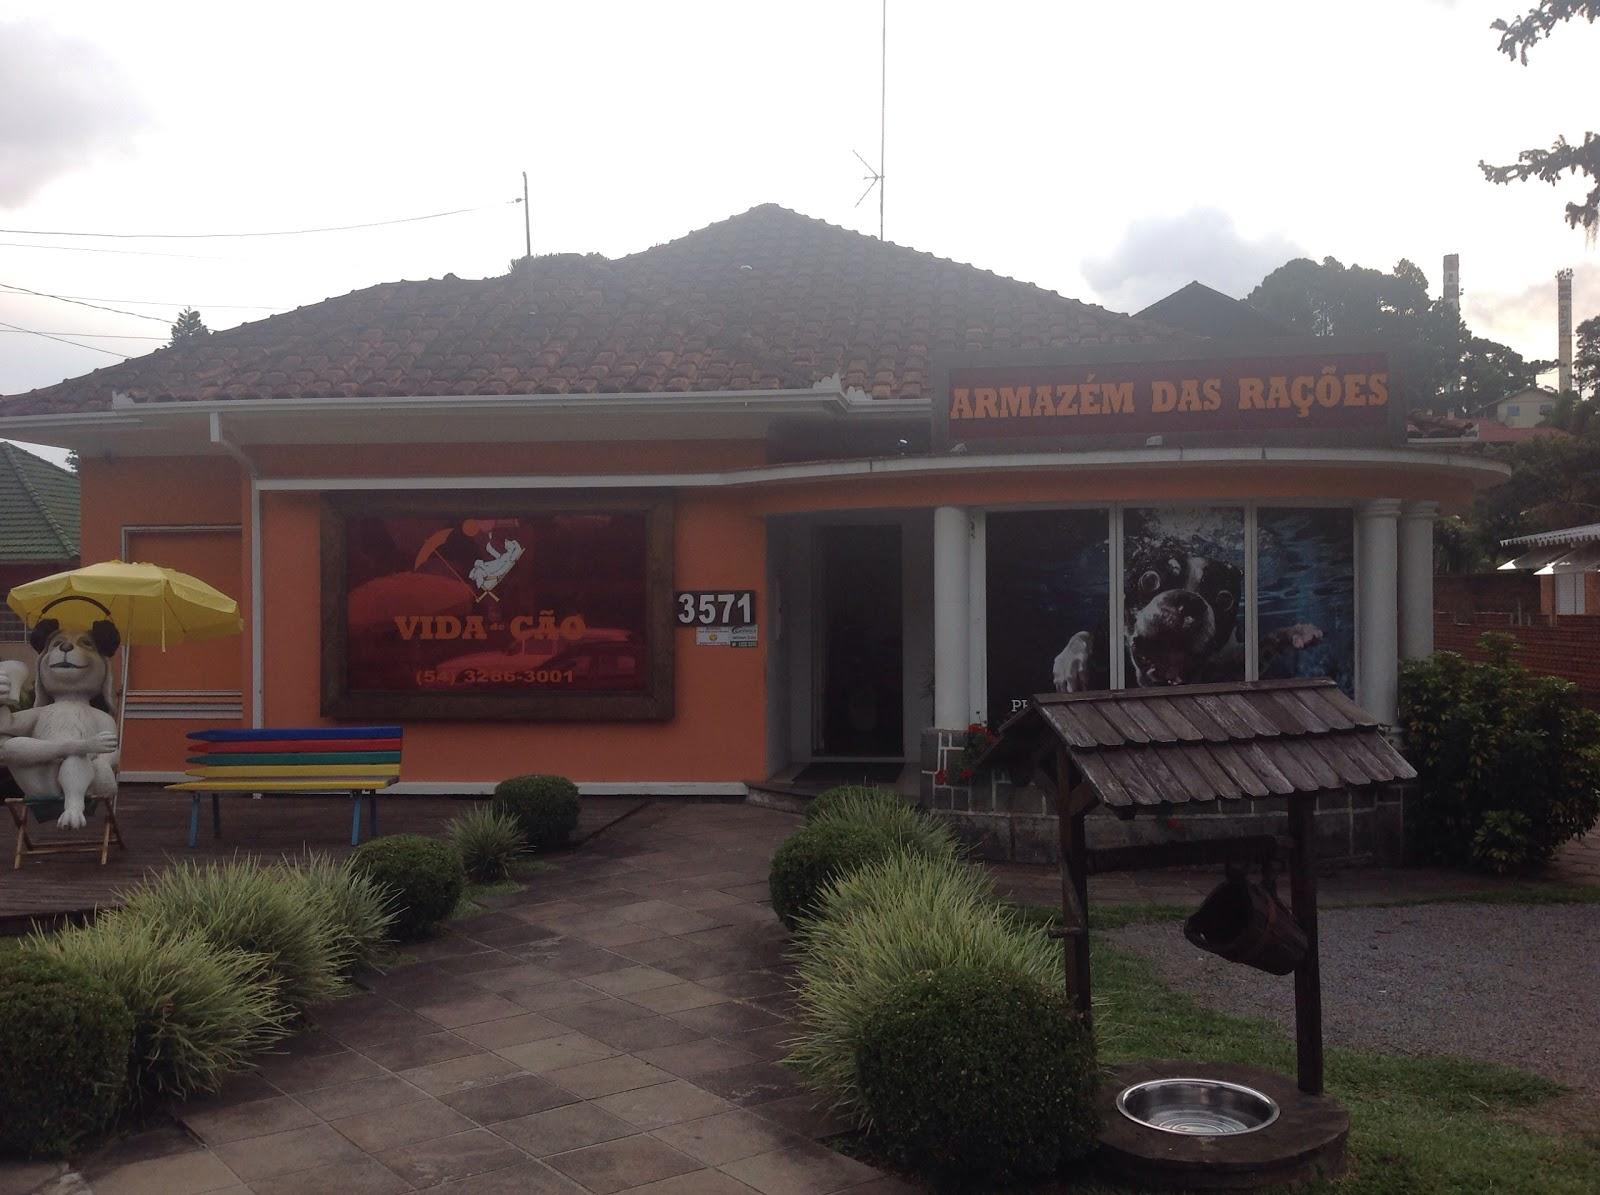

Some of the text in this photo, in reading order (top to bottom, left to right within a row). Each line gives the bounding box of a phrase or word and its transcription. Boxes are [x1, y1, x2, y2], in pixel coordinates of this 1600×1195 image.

[950, 365, 1389, 420] ARMAZÉM DAS RAÇÕES
[678, 593, 751, 624] 3571
[394, 615, 488, 640] VIDA
[510, 609, 586, 640] CÃO
[415, 670, 574, 686] (54) 3286-3001
